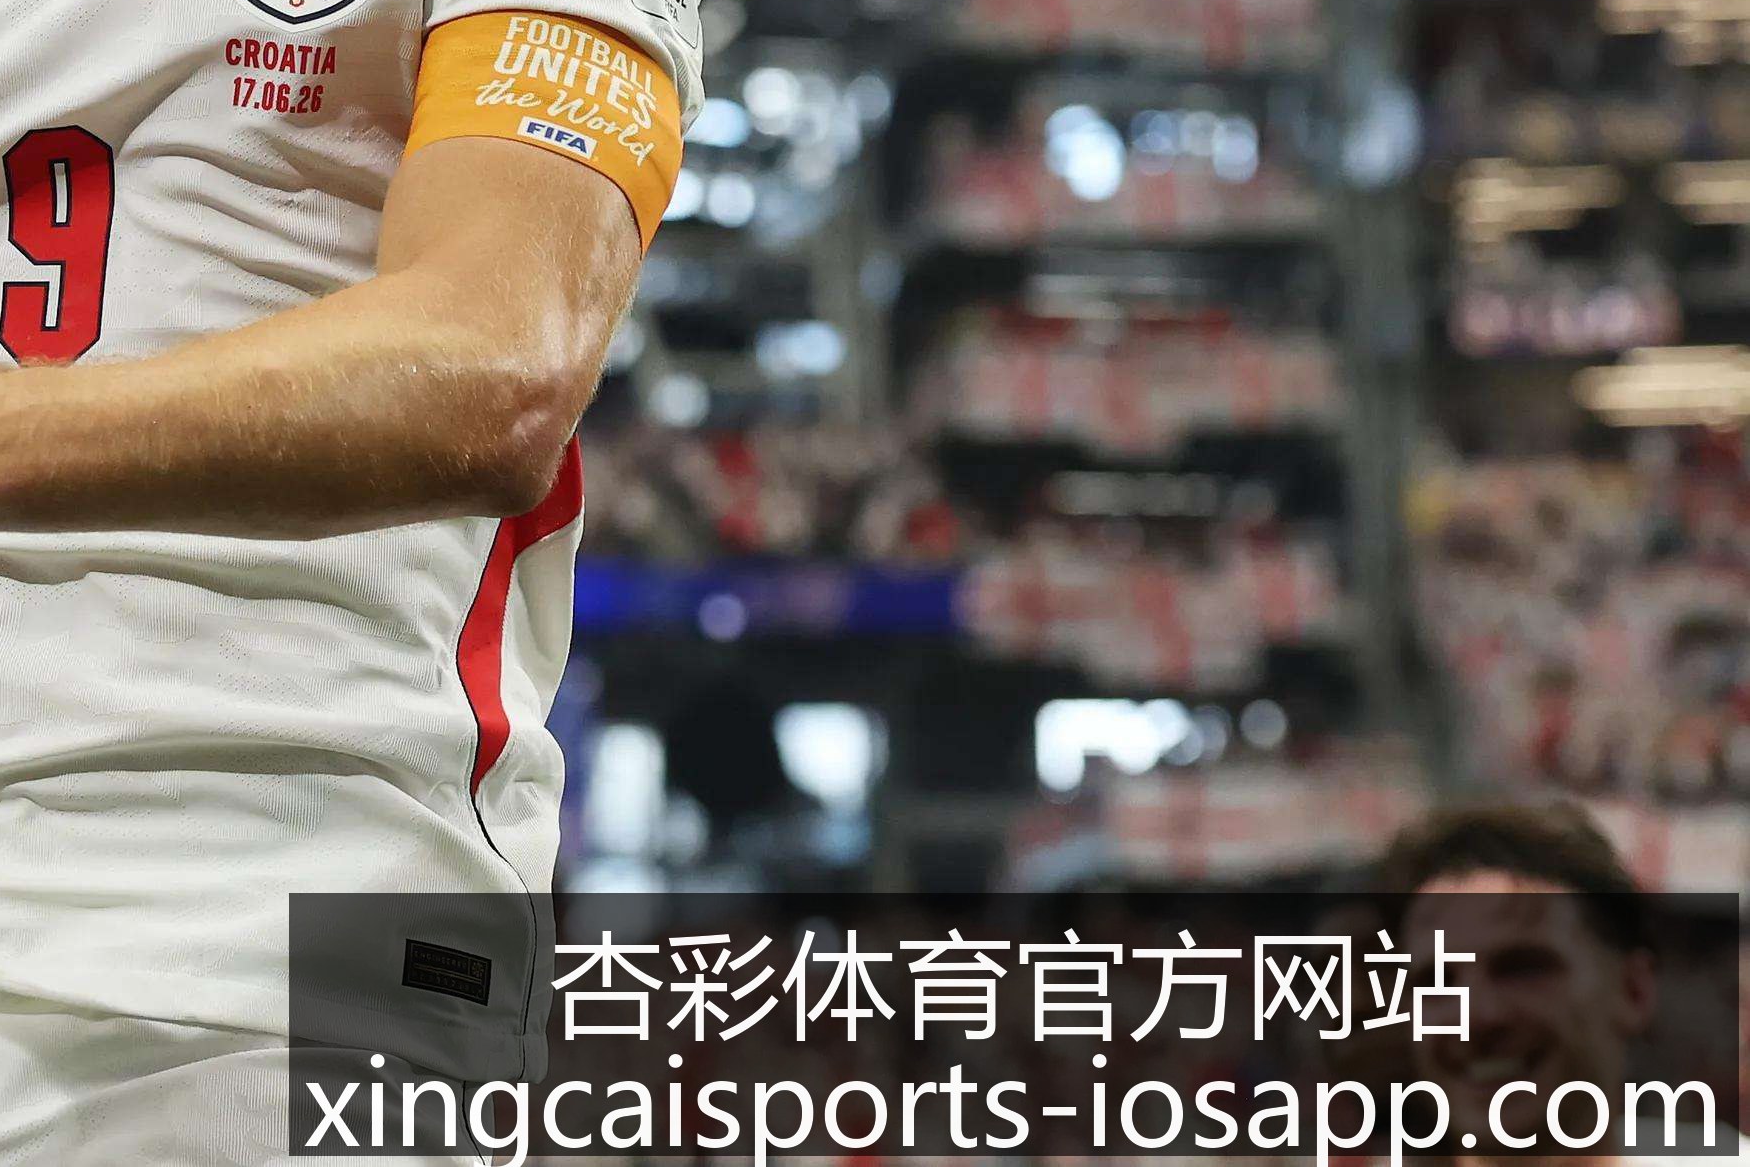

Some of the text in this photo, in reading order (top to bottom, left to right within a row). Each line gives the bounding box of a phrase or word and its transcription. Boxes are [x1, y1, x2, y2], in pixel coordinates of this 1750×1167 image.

[225, 38, 336, 75] CROATIA
[494, 41, 658, 131] UNITES
[506, 16, 658, 102] FOOTBALL
[232, 76, 325, 114] 17.06.26
[474, 78, 655, 167] the World
[525, 120, 590, 155] FIFA
